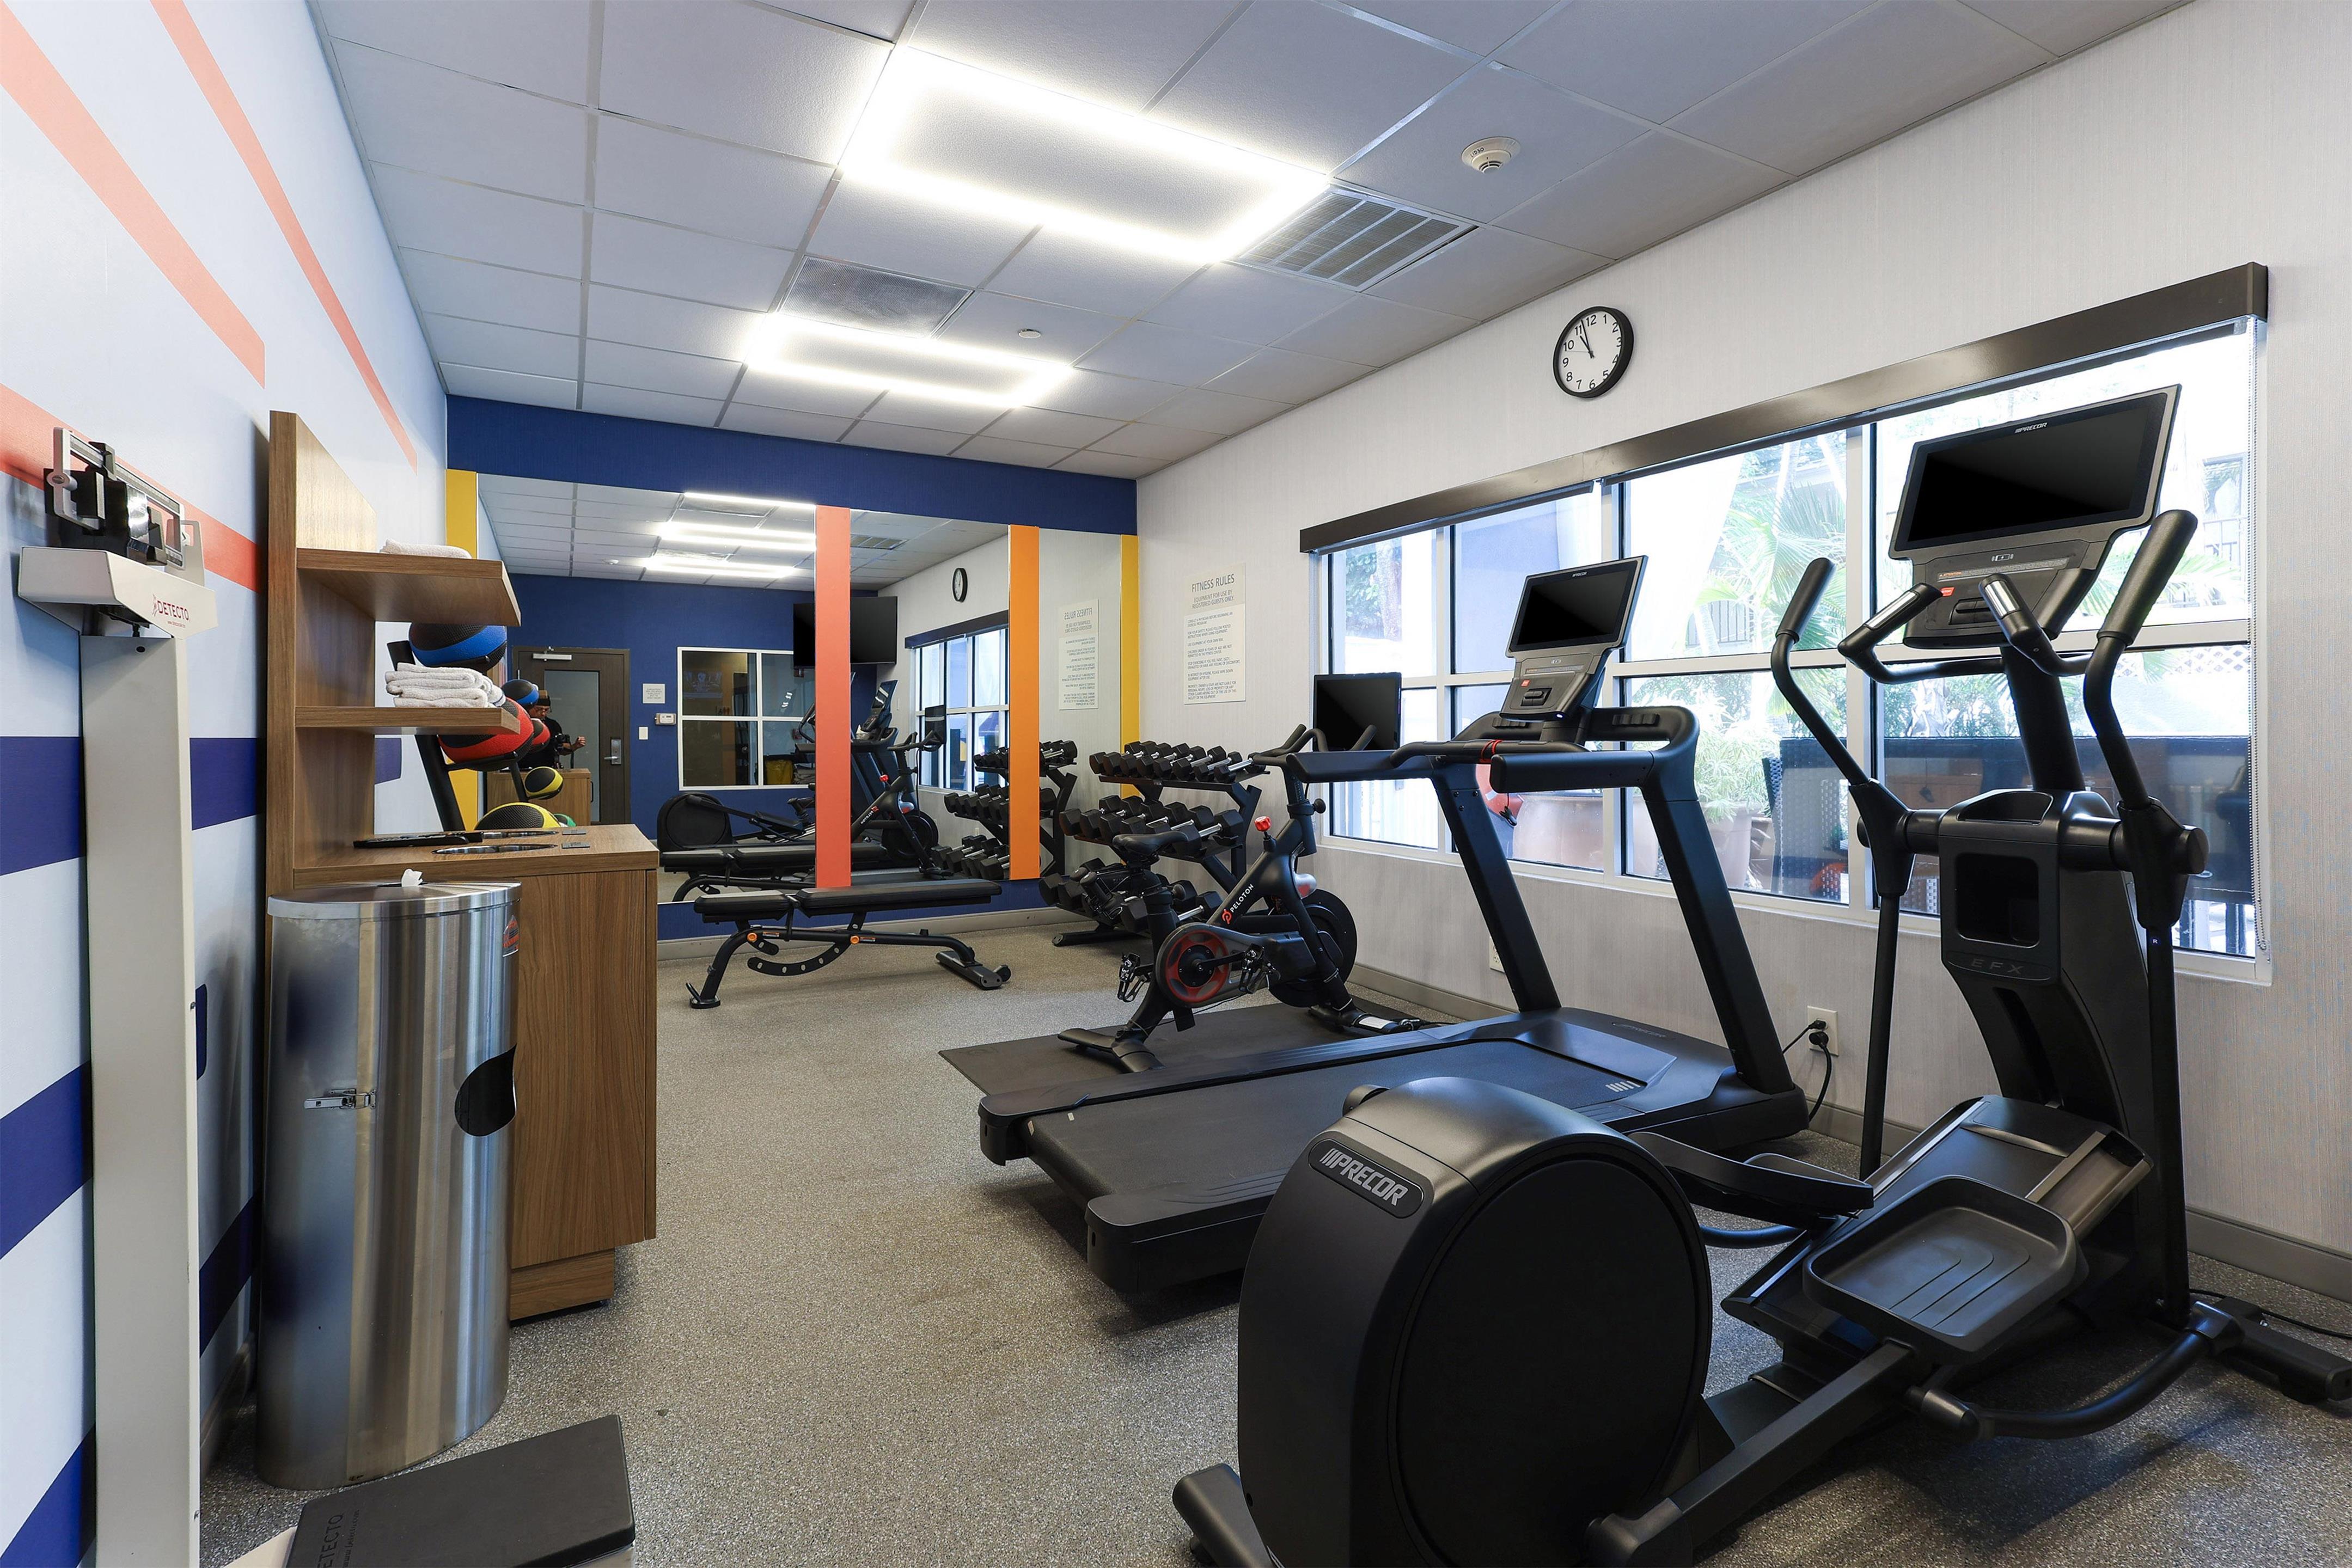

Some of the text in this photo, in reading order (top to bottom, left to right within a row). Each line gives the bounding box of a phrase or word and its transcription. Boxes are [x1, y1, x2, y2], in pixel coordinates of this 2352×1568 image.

[1586, 314, 1596, 327] 12
[1603, 314, 1606, 324] 1
[1575, 324, 1582, 335] 11
[1612, 322, 1618, 333] 2
[1563, 340, 1574, 351] 10
[1616, 337, 1622, 347] 3
[1562, 357, 1569, 367] 9
[1612, 354, 1618, 363] 4
[1566, 372, 1573, 382] 8
[1603, 370, 1609, 381] 5
[1576, 379, 1582, 389] 7
[1589, 379, 1596, 389] 6
[2014, 422, 2048, 433] PRECOR
[1192, 573, 1235, 592] FITNESS RULES
[1194, 593, 1212, 603] EQUIPMENT
[157, 600, 189, 621] DETECTO
[1192, 601, 1211, 609] REGISTERED
[1230, 884, 1254, 913] PELOTON
[1971, 958, 2025, 974] EFX
[1319, 1148, 1408, 1206] PRECOR
[317, 1514, 343, 1568] ETECTO
